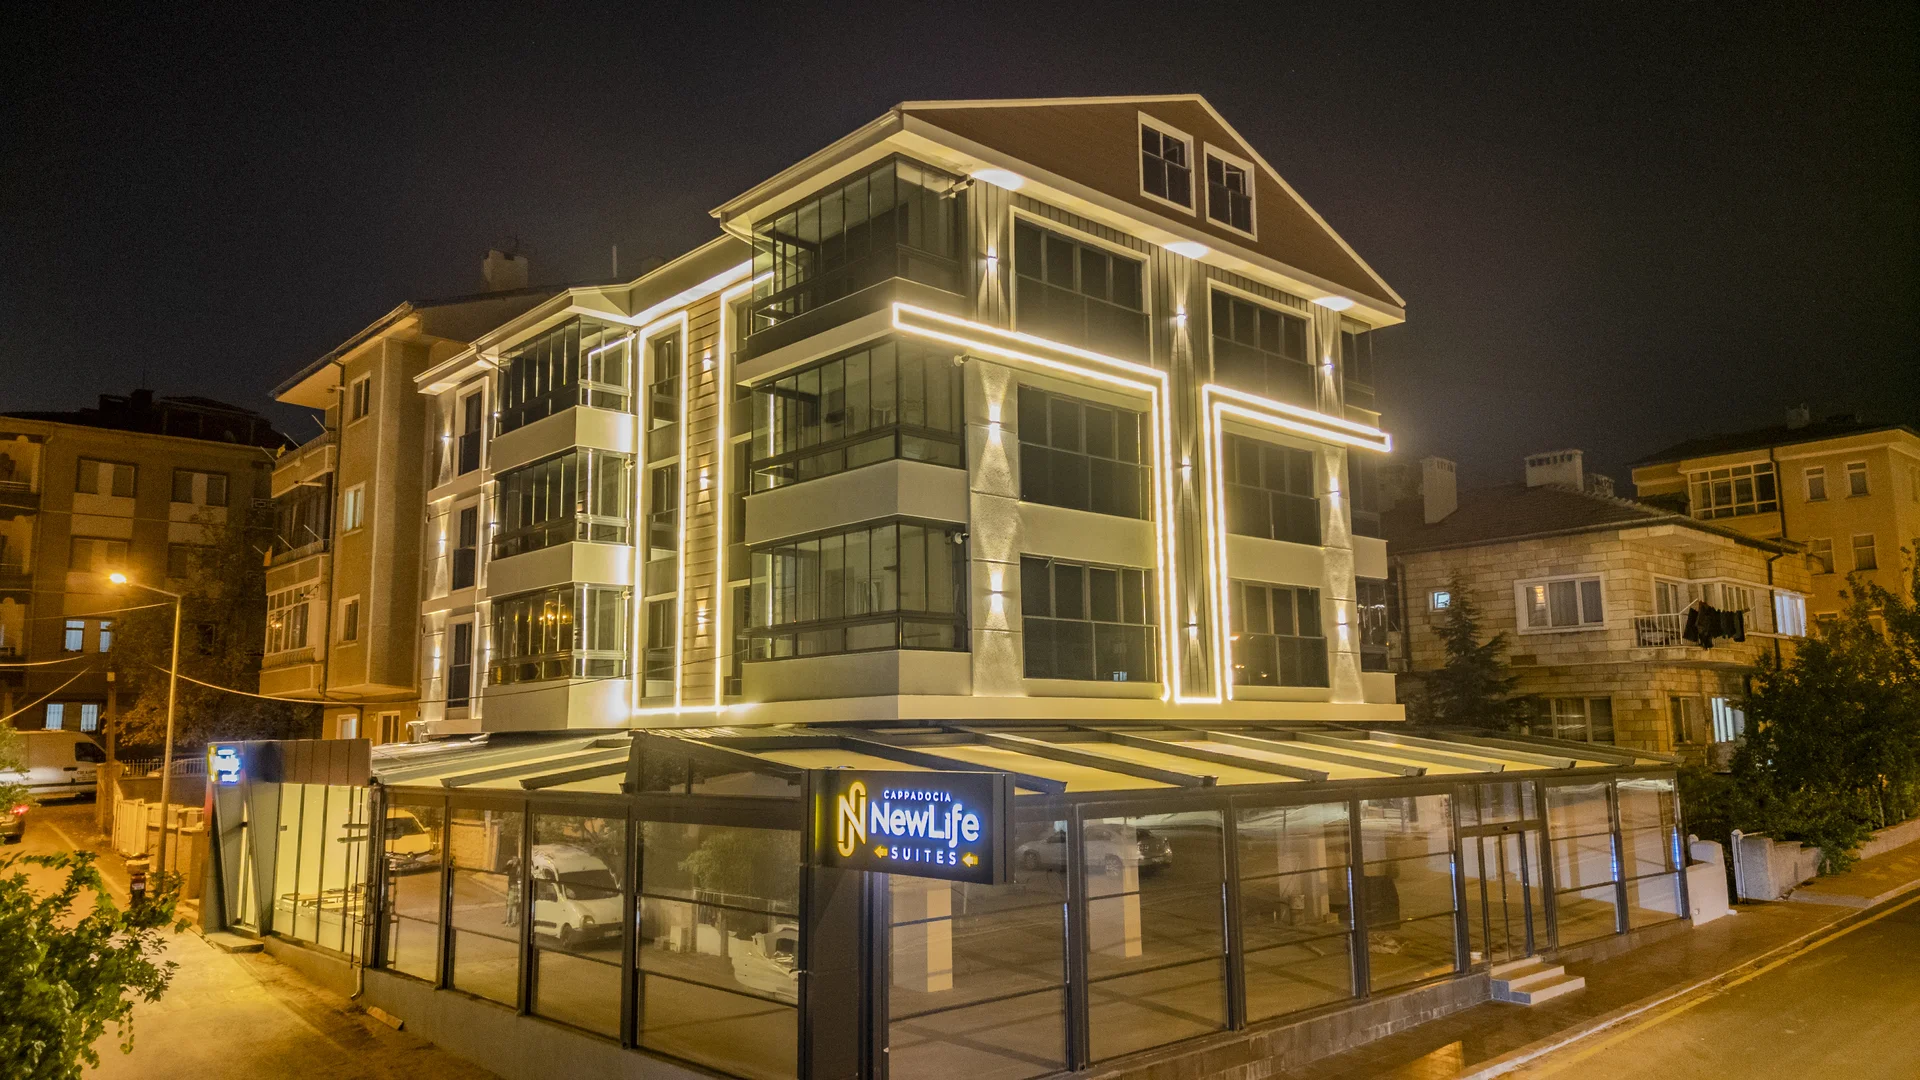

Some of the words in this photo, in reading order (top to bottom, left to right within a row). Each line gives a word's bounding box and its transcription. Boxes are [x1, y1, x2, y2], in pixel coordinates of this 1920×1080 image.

[883, 789, 952, 802] CAPPADOCIA
[870, 801, 980, 848] NewLife
[891, 846, 957, 865] SUITES
